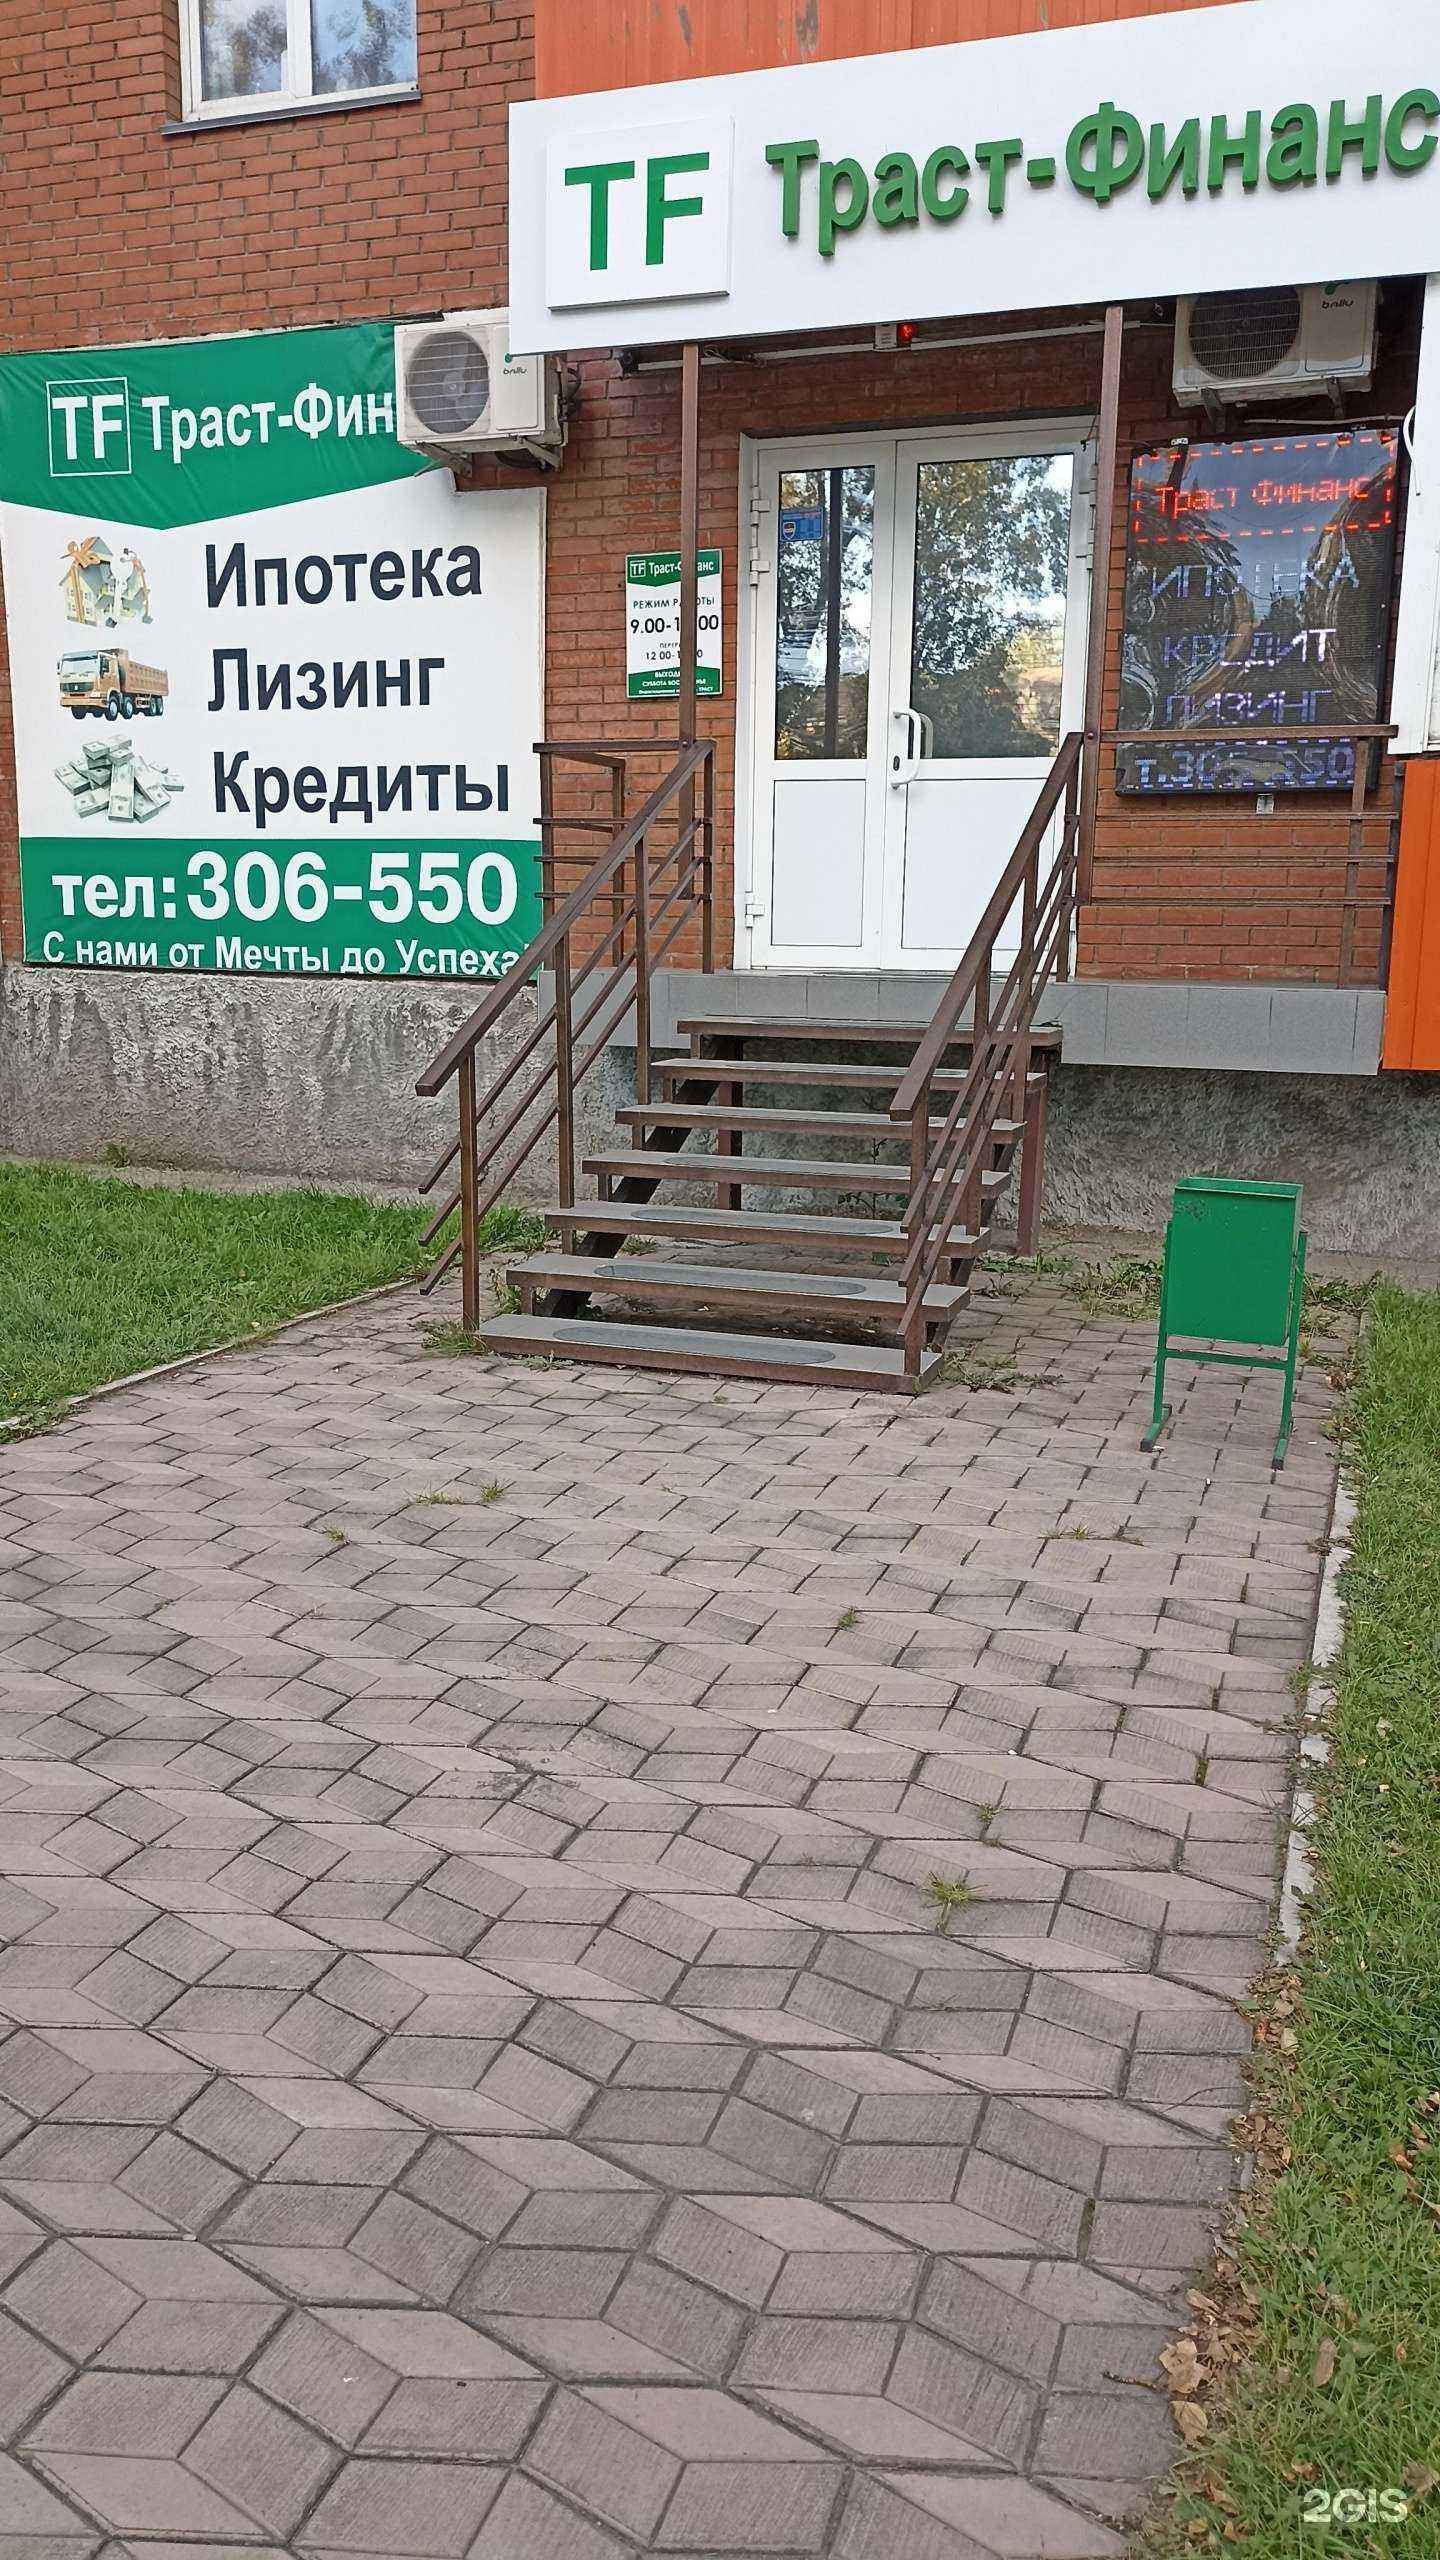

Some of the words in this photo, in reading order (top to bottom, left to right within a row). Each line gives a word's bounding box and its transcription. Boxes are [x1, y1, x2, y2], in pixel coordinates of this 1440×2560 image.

[765, 87, 1440, 257] Траст-Финанс
[564, 152, 710, 271] TF
[52, 394, 124, 460] TF
[142, 383, 393, 464] Траст-Фин
[1156, 486, 1240, 519] Траст
[1253, 477, 1370, 506] Финанс
[205, 542, 482, 609] Ипотека
[630, 562, 645, 576] TF
[649, 560, 714, 577] Траст-анс
[630, 614, 719, 634] 9.00-100
[633, 599, 670, 609] РЕЖИМ
[673, 596, 715, 606] РТЫ
[208, 647, 445, 712] Лизинг
[213, 751, 508, 828] Кредиты
[43, 930, 64, 963] С
[76, 939, 157, 967] нами
[168, 941, 204, 968] от
[215, 935, 330, 972] Мечты
[341, 944, 386, 975] до
[395, 938, 529, 976] Успеха
